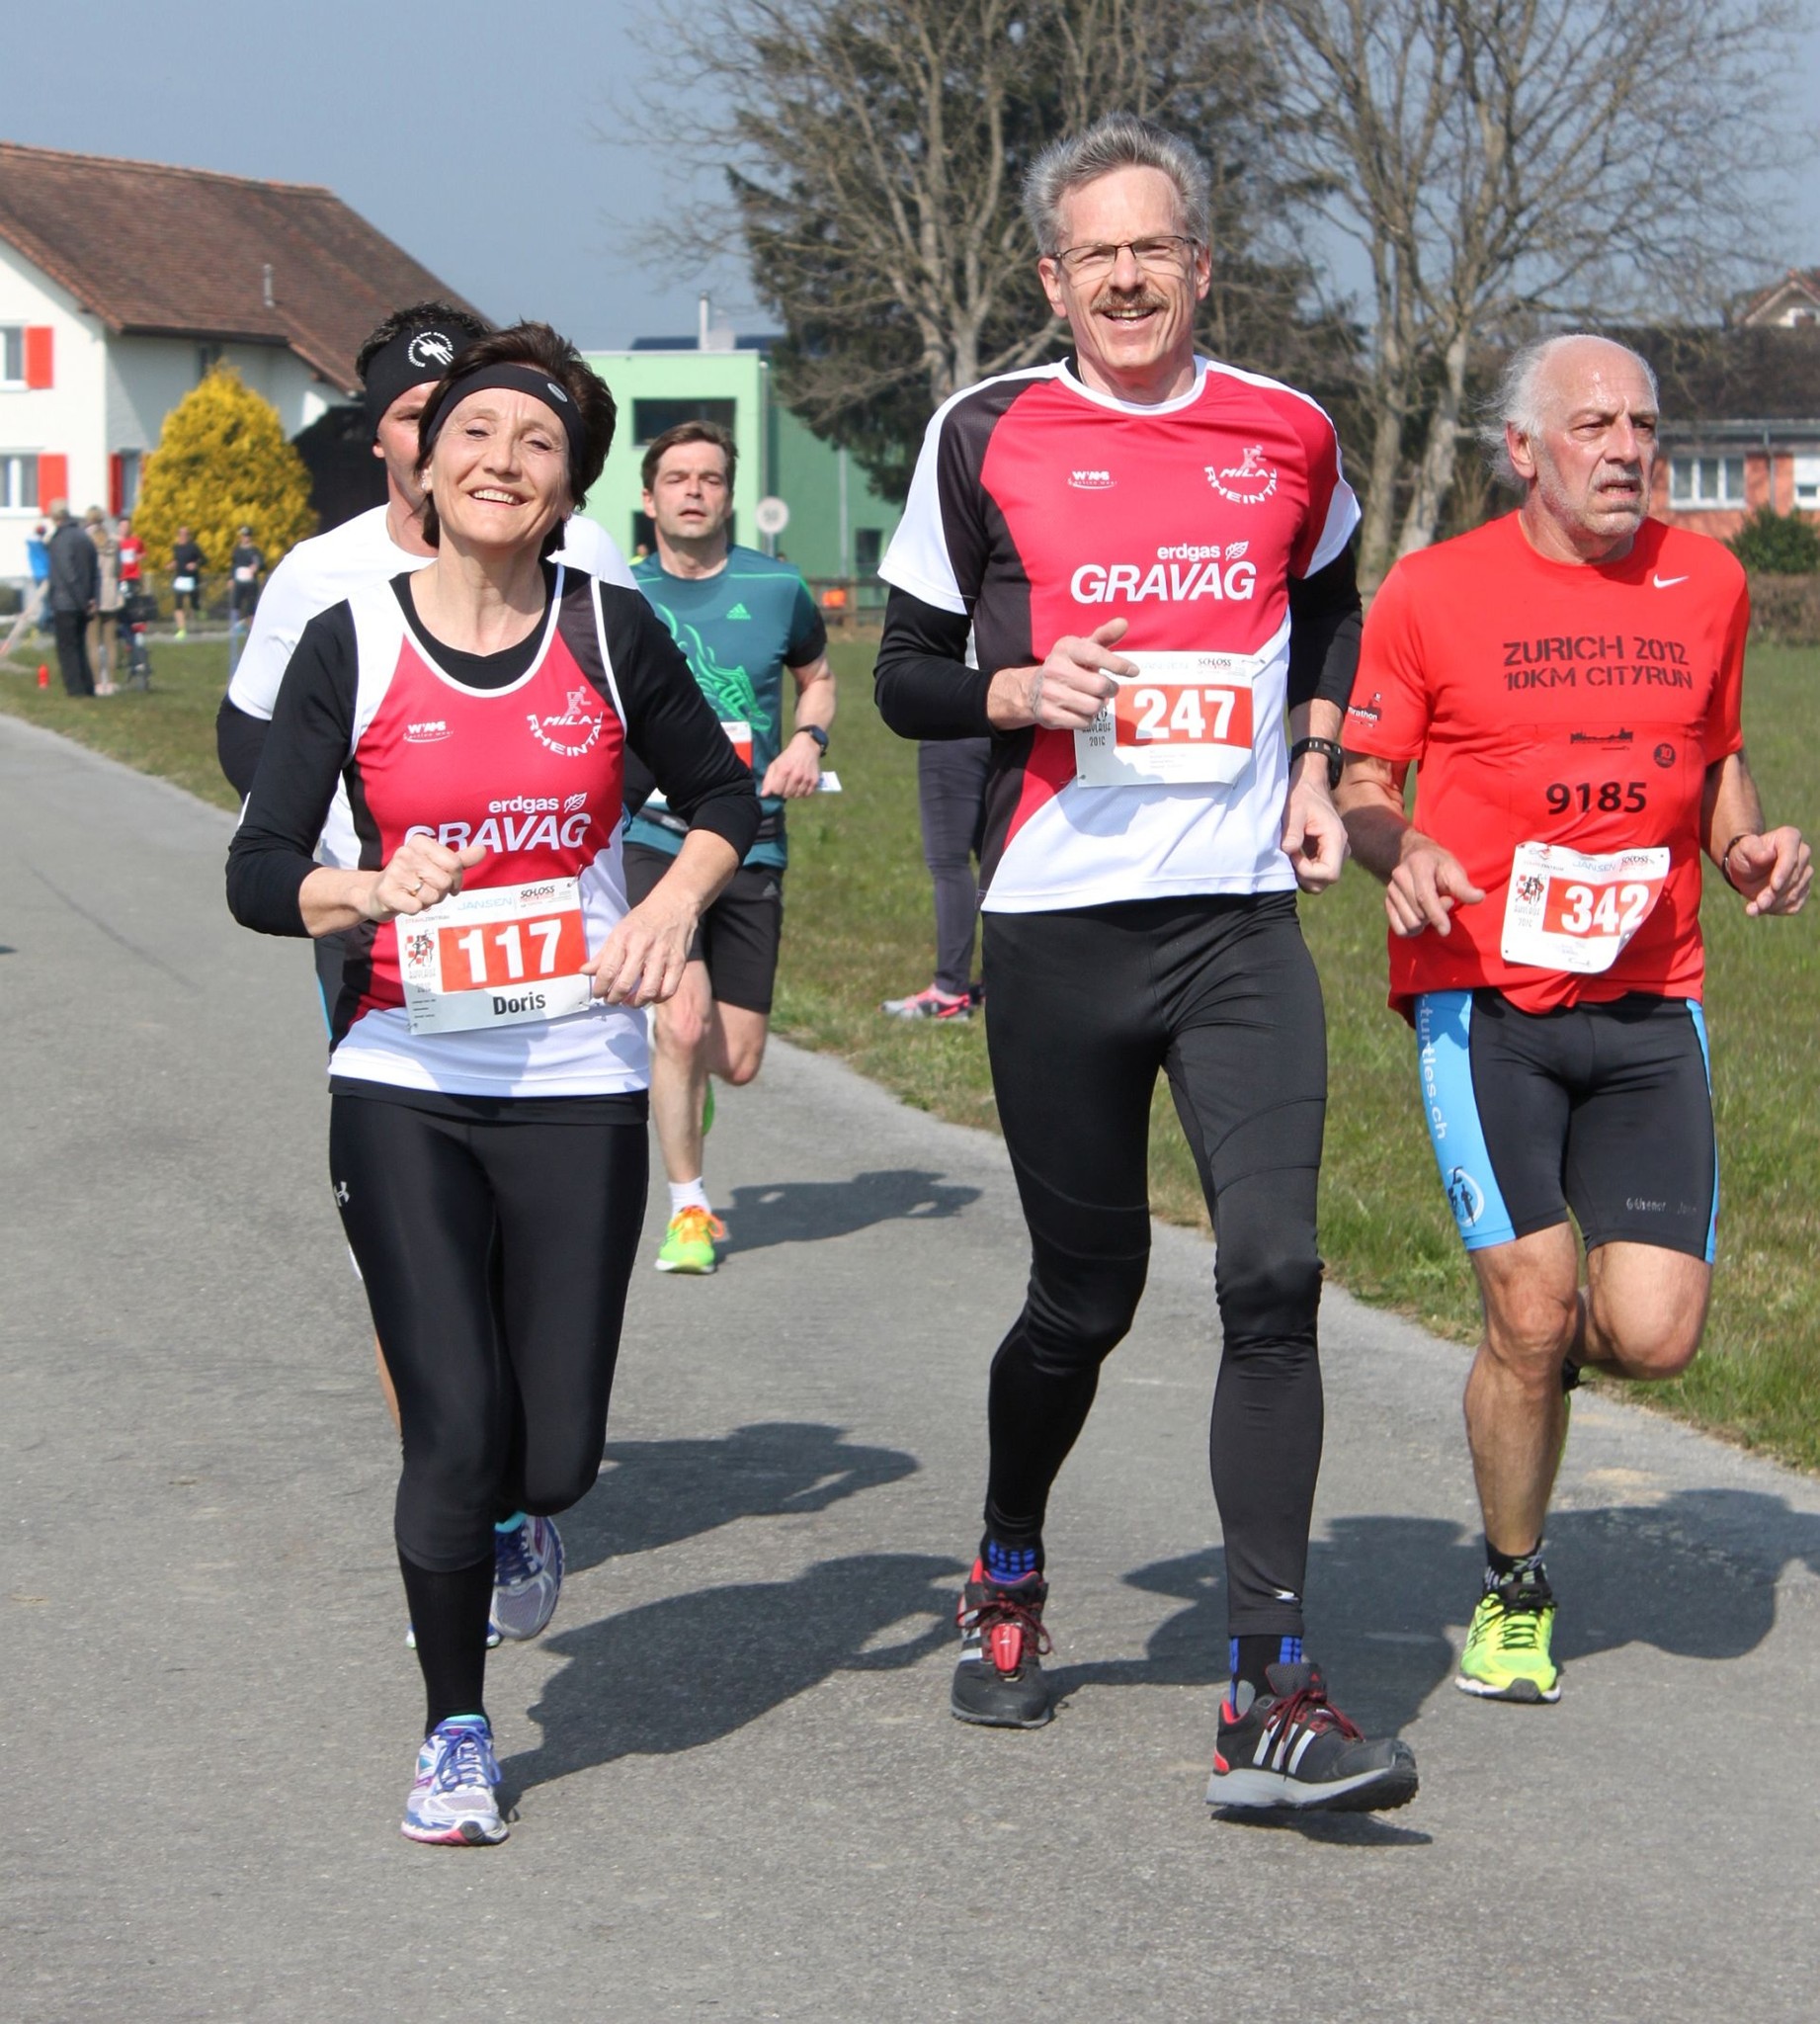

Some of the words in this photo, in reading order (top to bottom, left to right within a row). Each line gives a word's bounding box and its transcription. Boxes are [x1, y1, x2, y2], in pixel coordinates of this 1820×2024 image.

[1204, 466, 1278, 504] RHEINTAL
[1157, 544, 1221, 561] erdgas
[1070, 561, 1257, 604] GRAVAG
[1503, 635, 1624, 666] ZURICH
[1632, 635, 1690, 665] 2012
[1503, 666, 1576, 691] 10KM
[1587, 664, 1694, 690] CITYRUN
[1133, 688, 1235, 740] 247
[527, 712, 605, 757] RHEINTAL
[488, 795, 559, 813] erdgas
[1546, 781, 1647, 815] 9185
[1561, 884, 1650, 934] 342
[457, 918, 562, 983] 117
[493, 991, 546, 1016] Doris
[1420, 993, 1448, 1139] -turtles.ch
